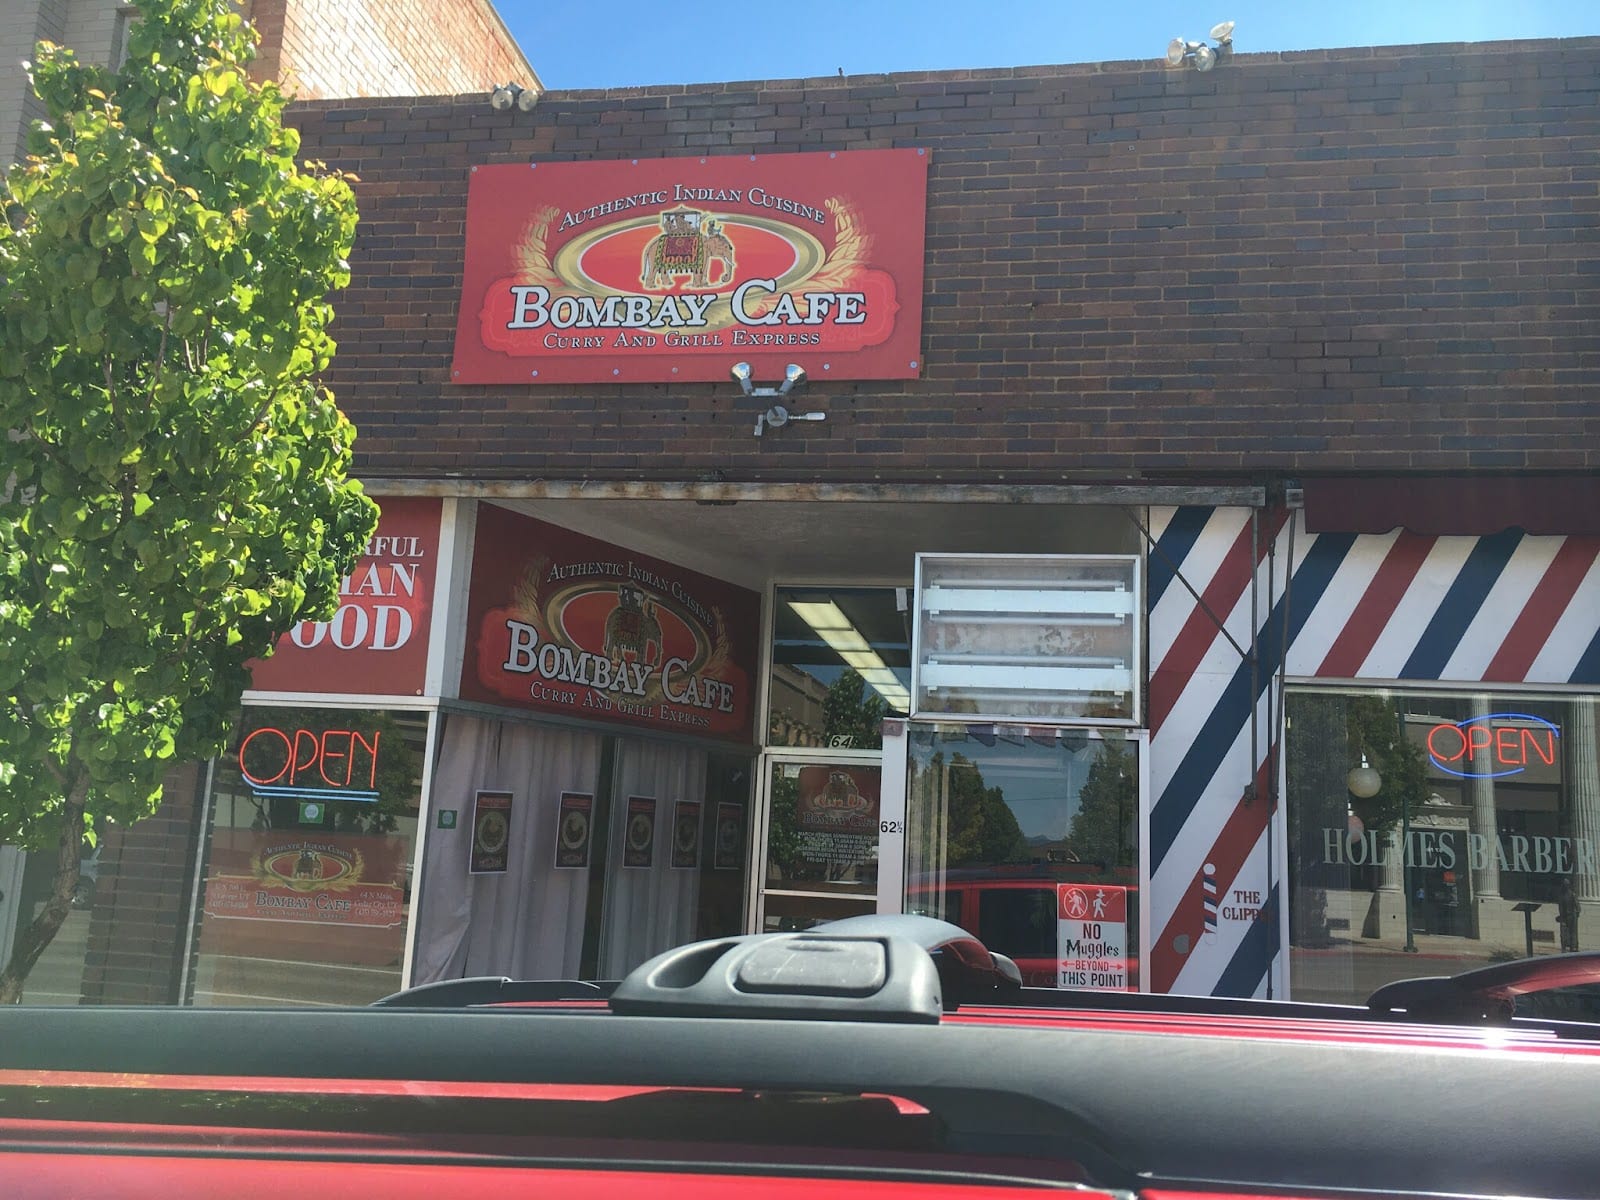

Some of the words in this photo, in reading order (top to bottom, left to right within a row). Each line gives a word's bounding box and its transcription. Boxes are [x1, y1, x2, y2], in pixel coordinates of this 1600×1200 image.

[558, 189, 667, 232] AUTHENTIC
[673, 183, 741, 203] INDIAN
[748, 187, 826, 225] CUISINE
[507, 285, 718, 330] BOMBAY
[731, 278, 866, 326] CAFE
[543, 332, 604, 349] CURRY
[613, 332, 656, 348] AND
[664, 331, 722, 347] GRILL
[732, 330, 820, 346] EXPRESS
[338, 562, 420, 598] IAN
[547, 561, 624, 583] AUTHENTIC
[627, 561, 669, 592] INDIAN
[671, 581, 713, 627] CUISINE
[289, 604, 413, 650] OOD
[503, 619, 654, 697] BOMBAY
[661, 657, 735, 713] CAFE
[530, 681, 577, 705] CURRY
[582, 693, 612, 711] AND
[617, 698, 654, 719] GRILL
[660, 704, 710, 728] EXPRESS
[239, 727, 381, 789] OPEN
[1427, 723, 1555, 766] OPEN
[1322, 828, 1455, 870] HOLMES
[1468, 833, 1598, 875] BARBER
[256, 891, 312, 909] BOMBAY
[315, 893, 351, 912] CAFE
[1233, 890, 1261, 905] THE
[1066, 939, 1120, 959] Muggles
[1082, 923, 1101, 939] NO
[1061, 971, 1086, 985] THIS
[1091, 972, 1124, 988] POINT
[1075, 960, 1109, 972] BEYOND
